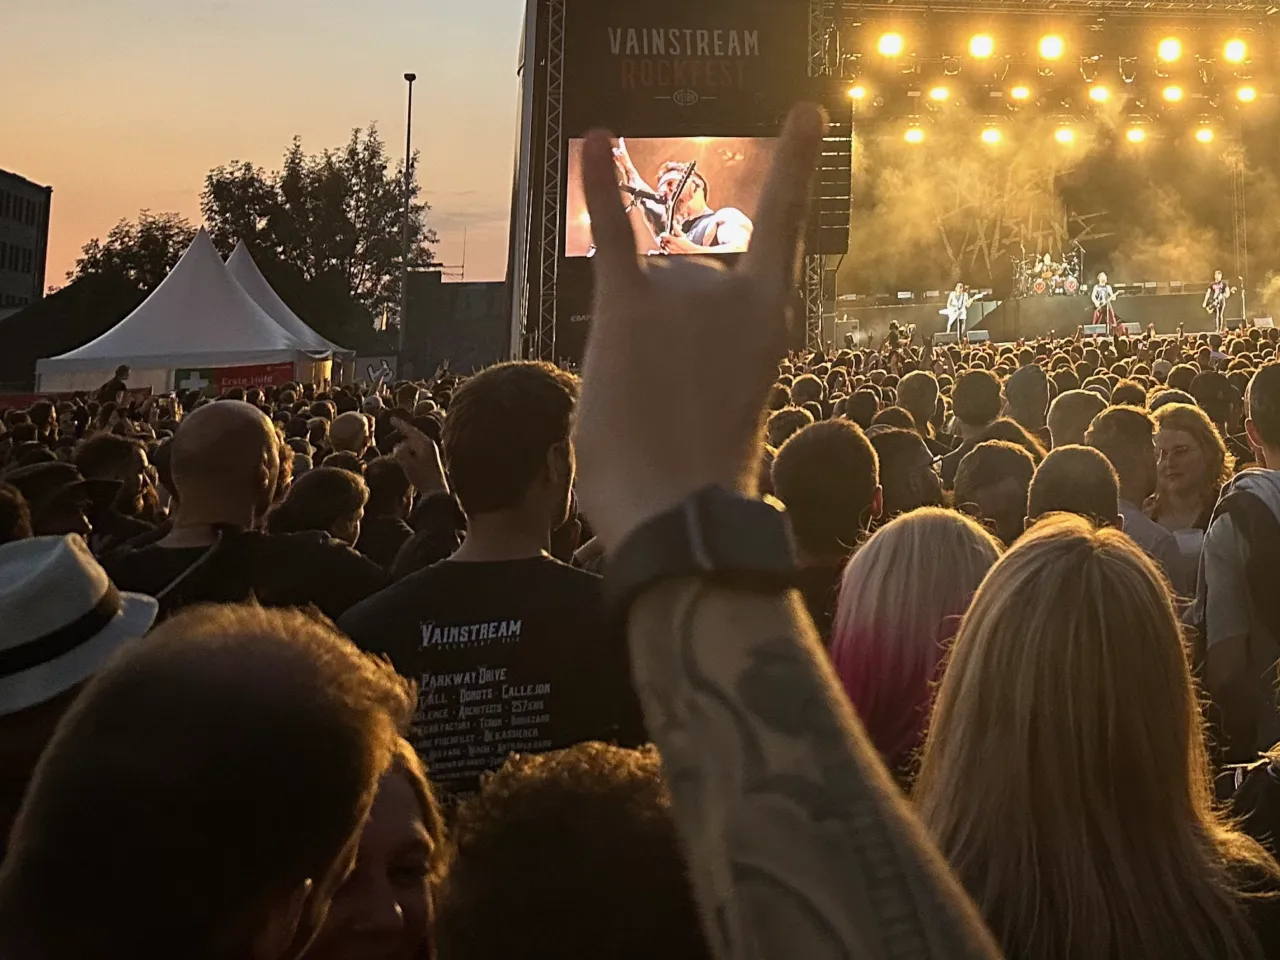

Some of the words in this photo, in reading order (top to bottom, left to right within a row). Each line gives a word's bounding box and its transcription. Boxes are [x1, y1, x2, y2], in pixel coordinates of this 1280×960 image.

[607, 26, 760, 56] VAINSTREAM
[620, 59, 746, 90] ROCKFEST
[221, 376, 248, 386] Erste
